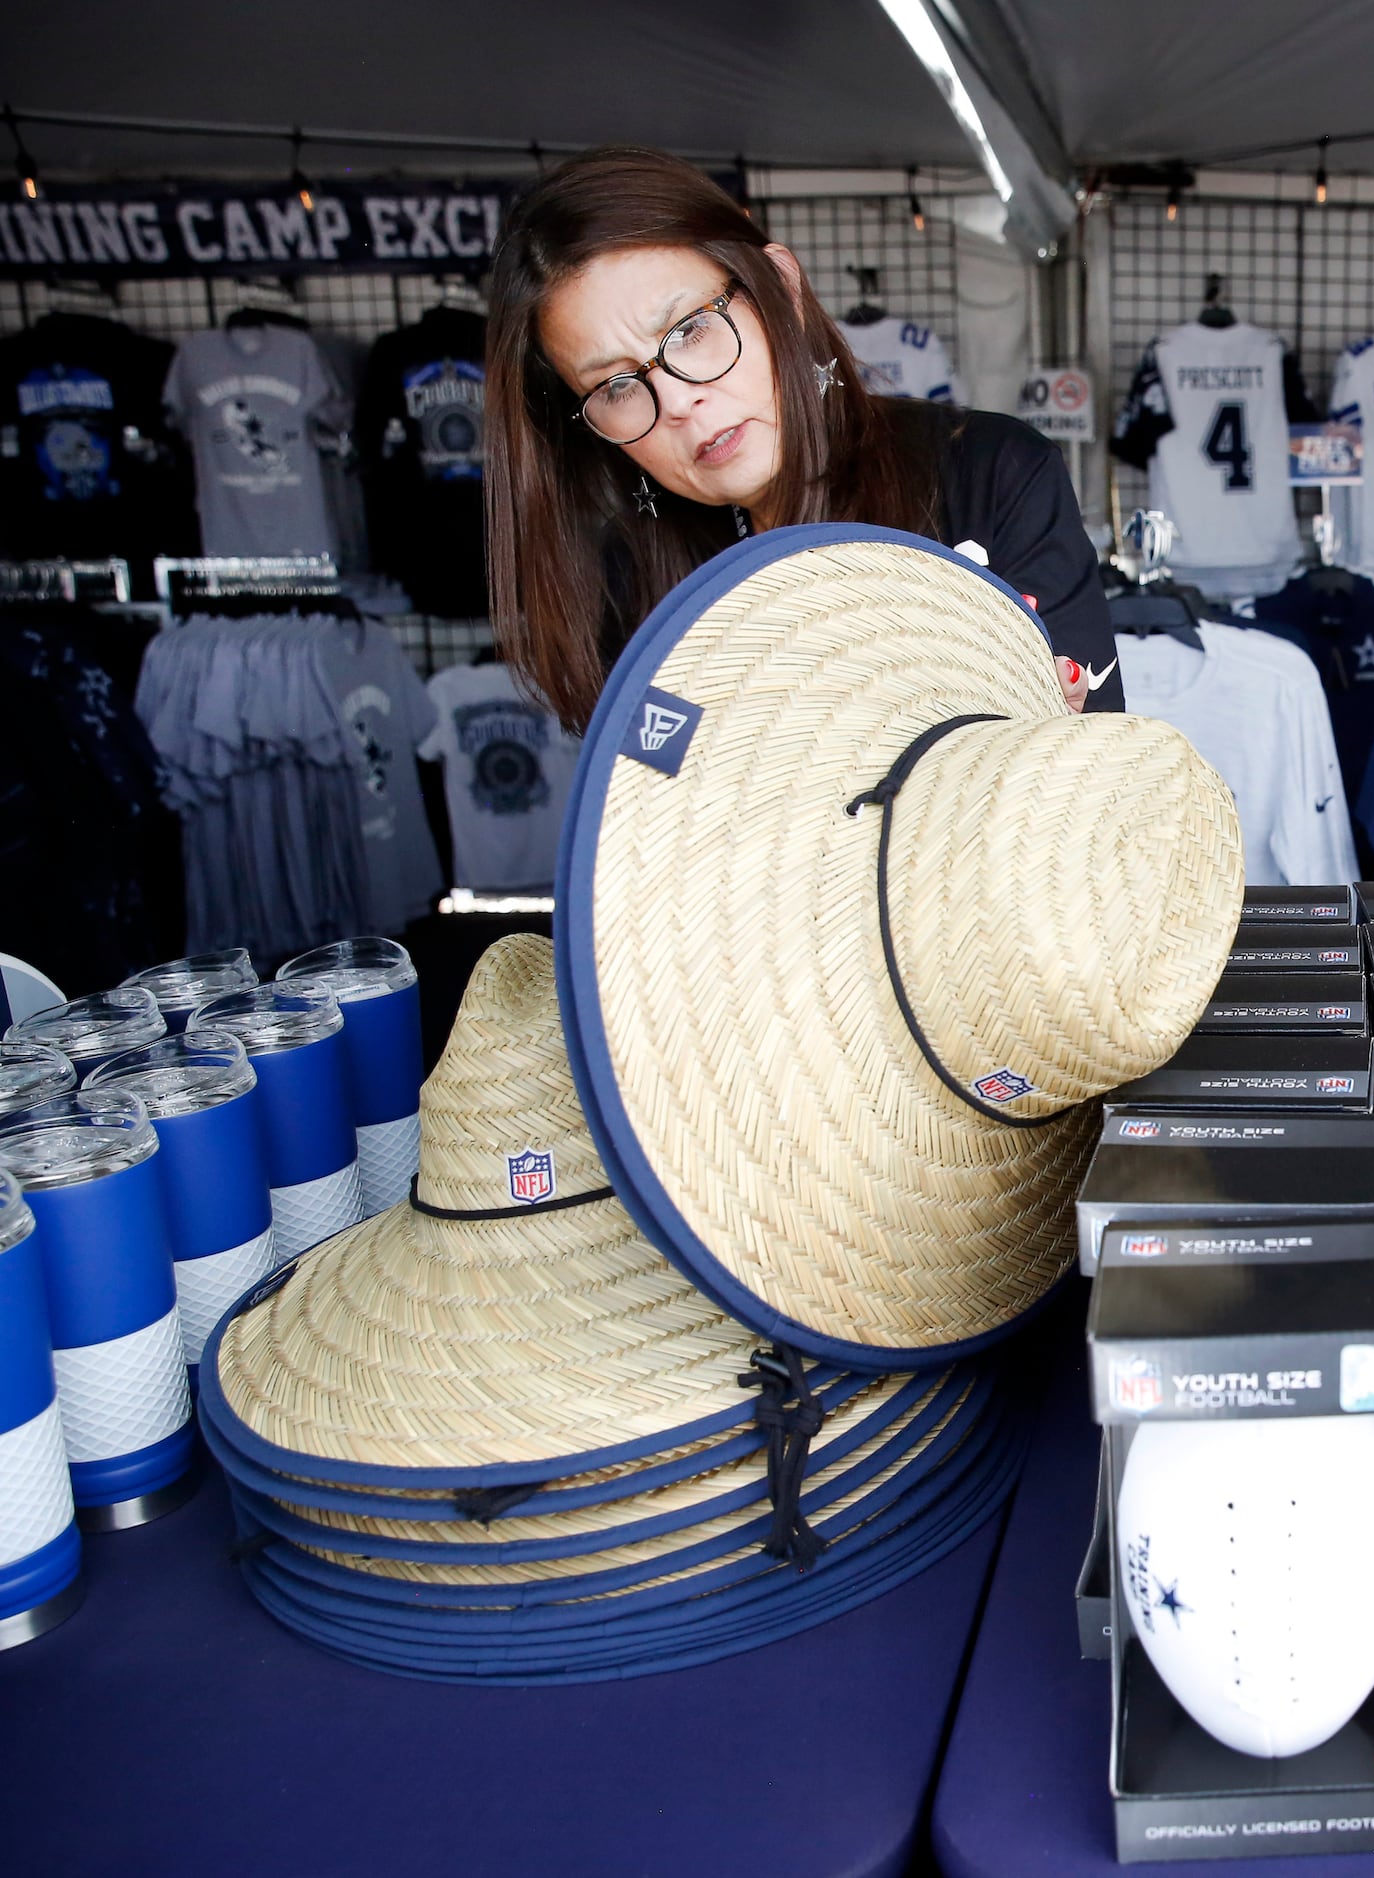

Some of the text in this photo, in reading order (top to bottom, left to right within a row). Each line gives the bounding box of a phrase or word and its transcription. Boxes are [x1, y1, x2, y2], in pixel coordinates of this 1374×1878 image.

[177, 198, 350, 262] CAMP
[1176, 365, 1264, 391] PRESCOTT
[1199, 398, 1256, 493] 4
[1169, 1126, 1285, 1135] YOUTH SIZE
[1178, 1236, 1313, 1249] YOUTH SIZE
[1172, 1370, 1323, 1391] YOUTH SIZE
[1174, 1390, 1297, 1408] FOOTBALL
[1145, 1823, 1237, 1840] OFFICIALLY
[1242, 1818, 1322, 1836] LICENSED
